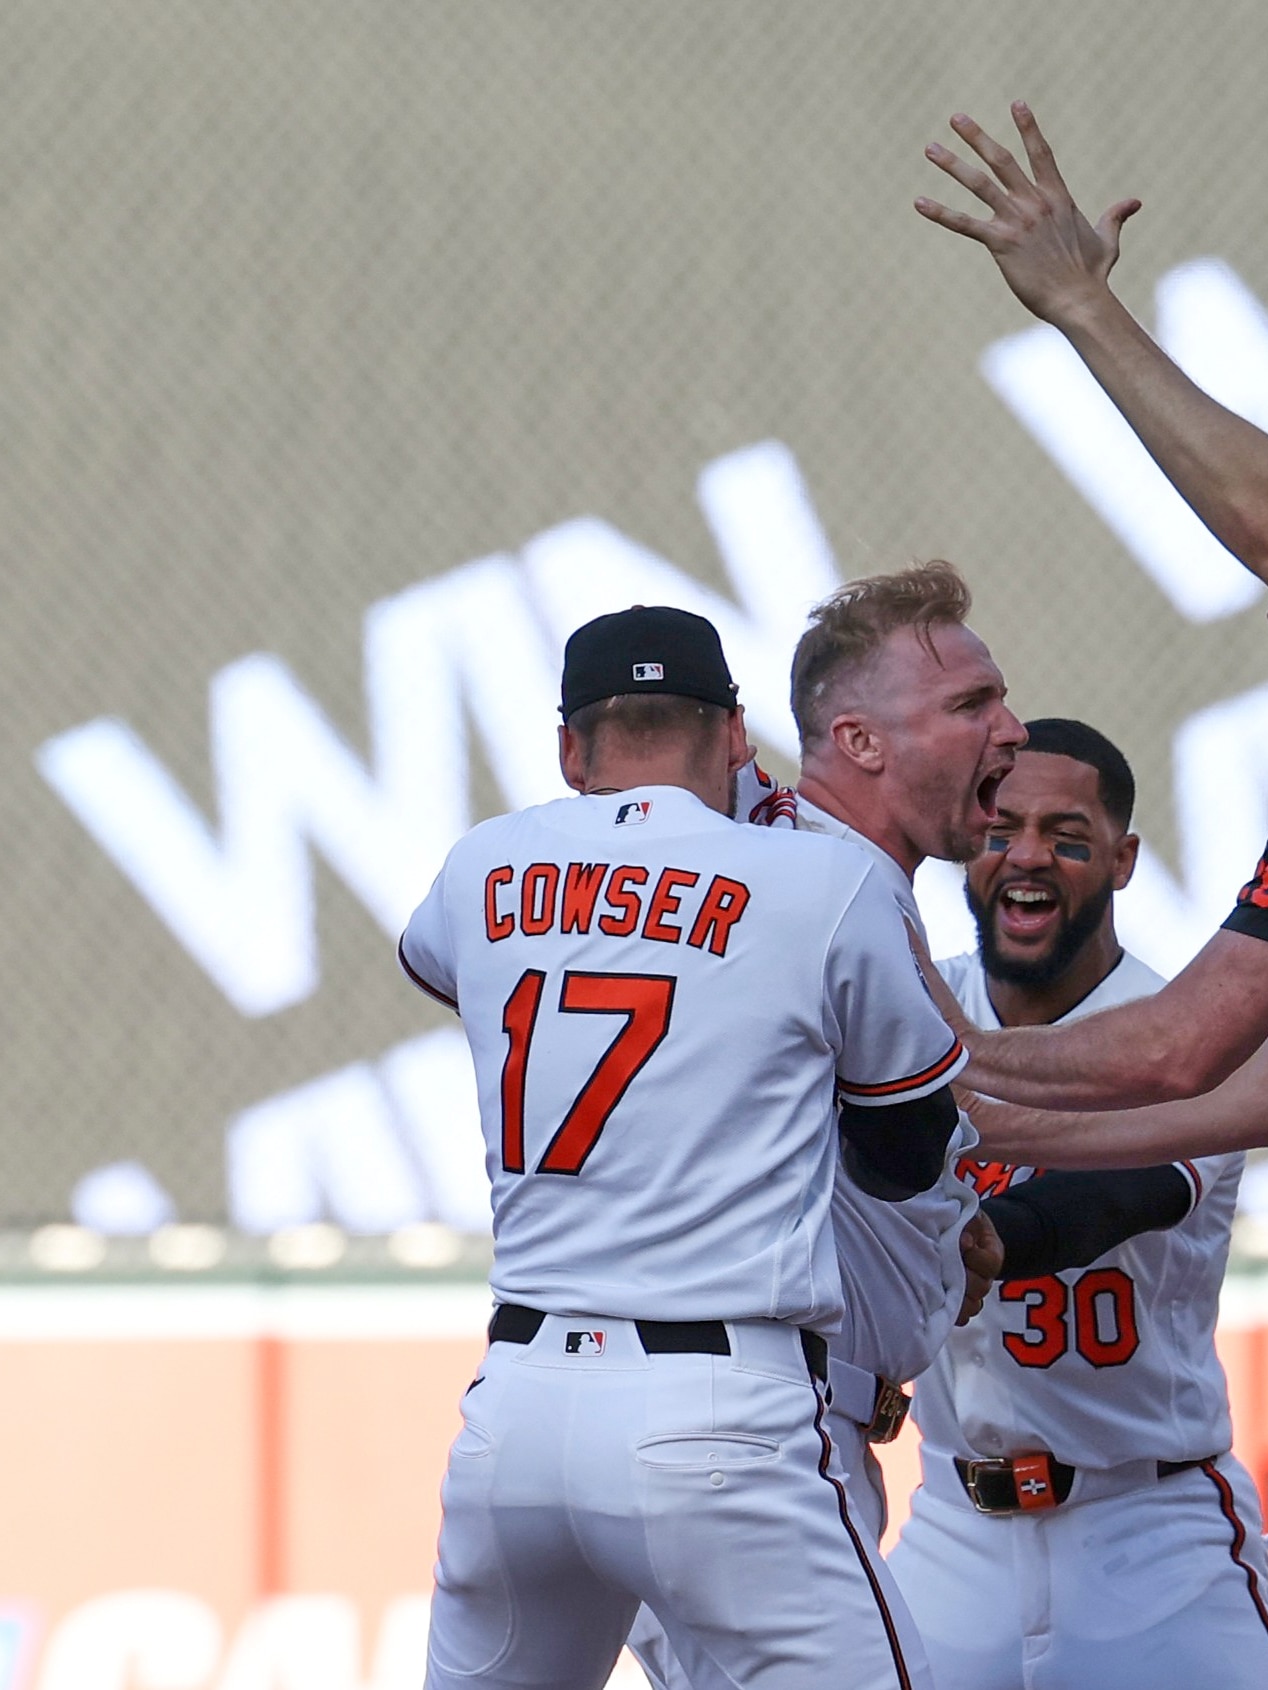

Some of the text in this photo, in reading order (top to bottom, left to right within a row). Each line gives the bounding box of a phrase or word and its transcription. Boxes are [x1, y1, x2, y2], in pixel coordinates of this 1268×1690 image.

[36, 438, 840, 1018] WIN
[484, 862, 751, 958] COWSER
[501, 968, 677, 1176] 17
[999, 1267, 1140, 1369] 30
